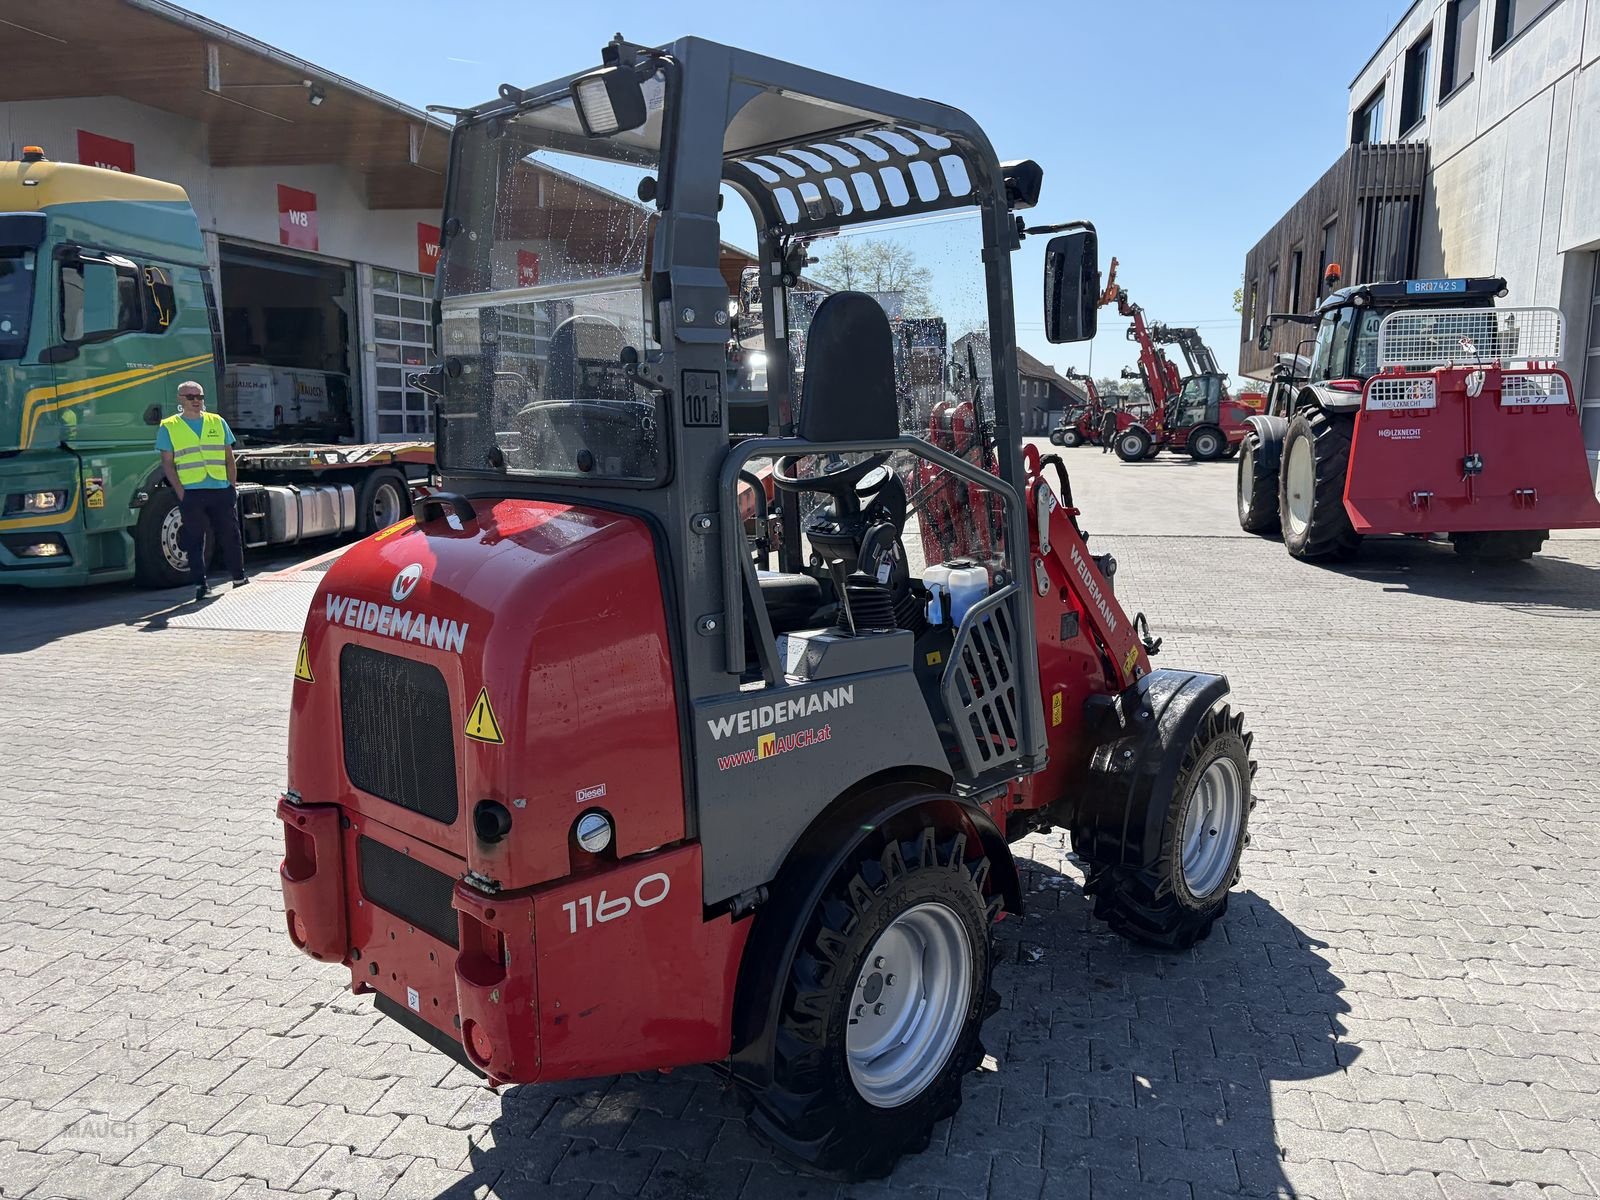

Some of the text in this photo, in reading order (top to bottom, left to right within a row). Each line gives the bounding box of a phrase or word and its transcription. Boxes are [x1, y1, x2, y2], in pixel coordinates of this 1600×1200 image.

[289, 209, 308, 227] W8
[425, 243, 440, 257] W7
[1366, 319, 1379, 332] 40
[686, 395, 708, 423] 101
[1382, 400, 1421, 408] HOLZKNECHT
[1378, 428, 1421, 437] HOLZKNECHT
[1070, 544, 1118, 632] WEIDEMANN
[326, 593, 469, 654] WEIDEMANN
[707, 684, 854, 740] WEIDEMANN
[717, 724, 831, 771] www.MAUCH.at
[578, 785, 605, 801] Diesel
[562, 872, 671, 934] 1160
